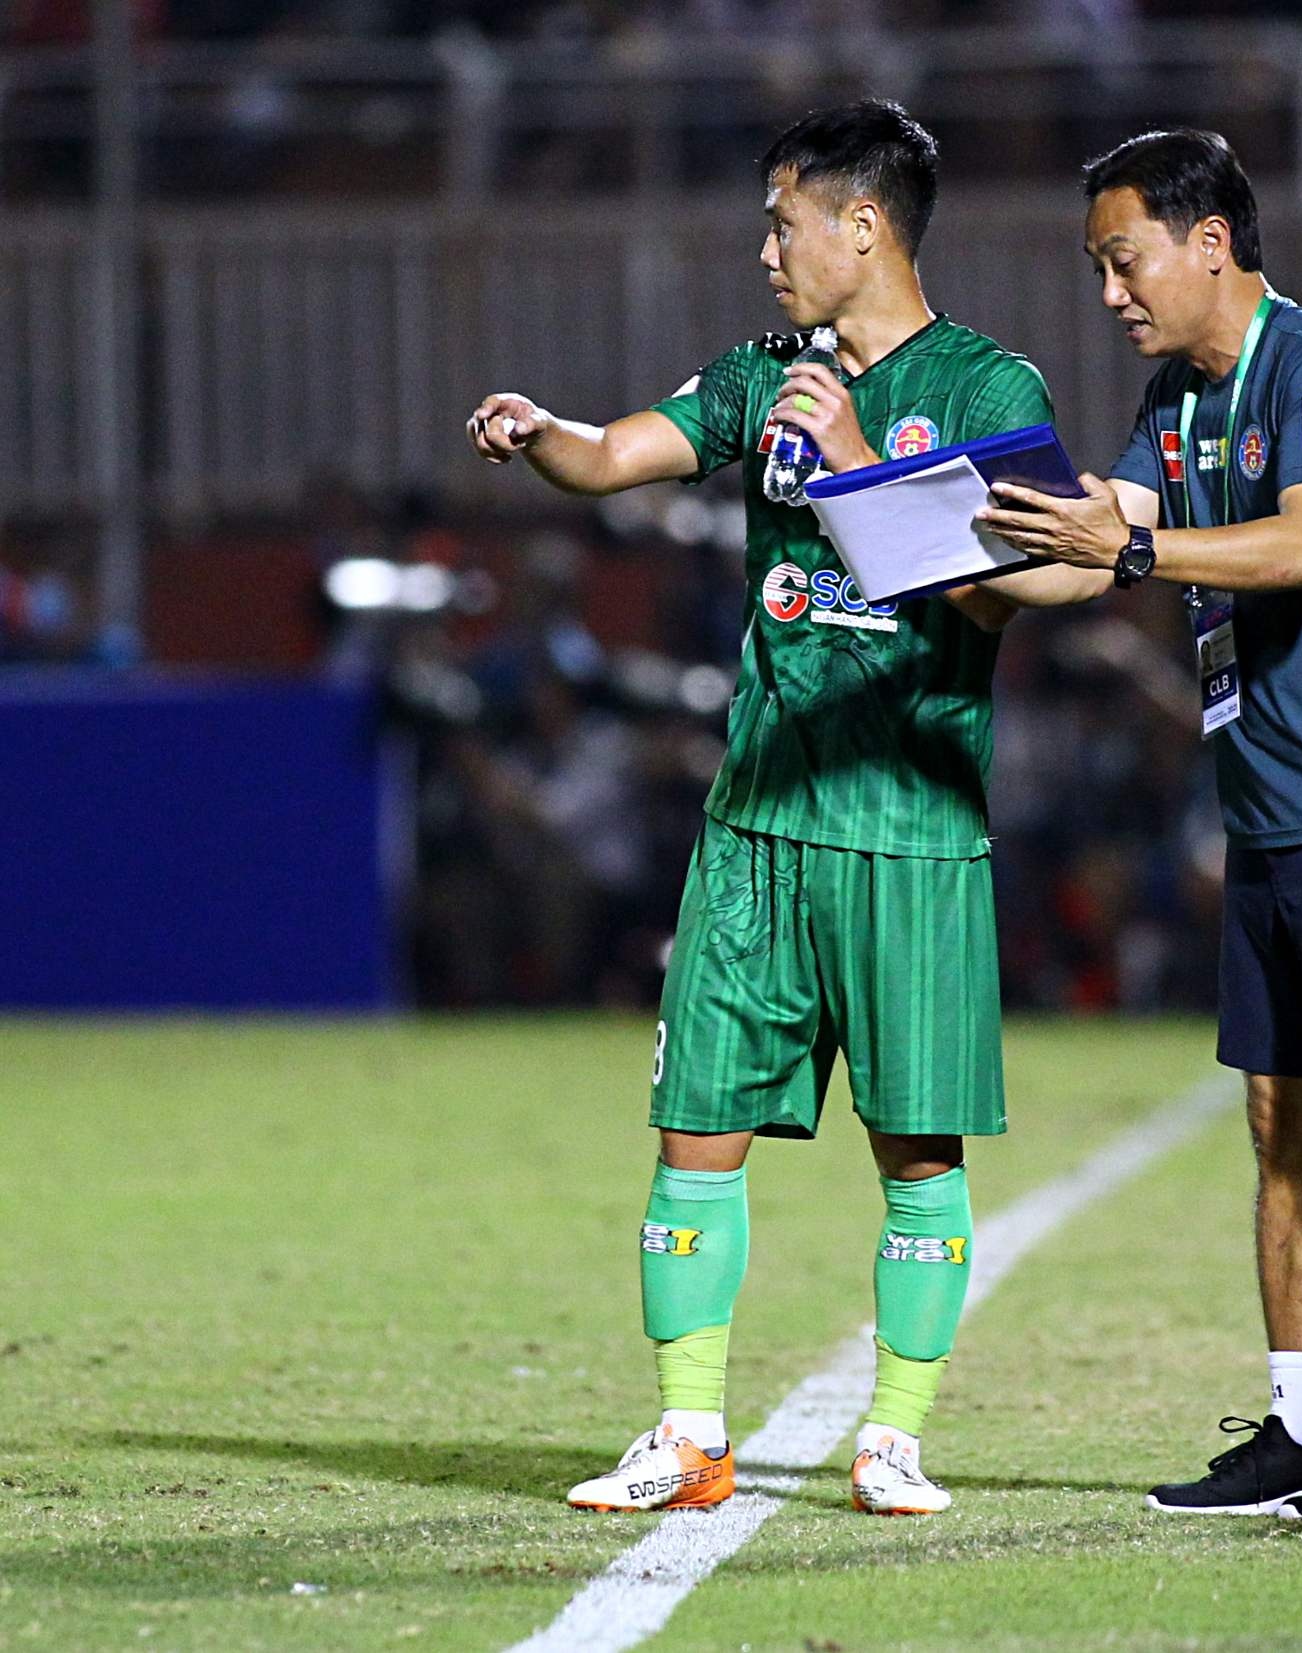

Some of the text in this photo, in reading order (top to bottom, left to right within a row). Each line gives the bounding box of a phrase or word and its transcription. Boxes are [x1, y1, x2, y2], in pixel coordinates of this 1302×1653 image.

[811, 570, 898, 616] SC
[1209, 674, 1230, 697] CLB
[886, 1233, 943, 1249] we
[880, 1246, 945, 1263] are
